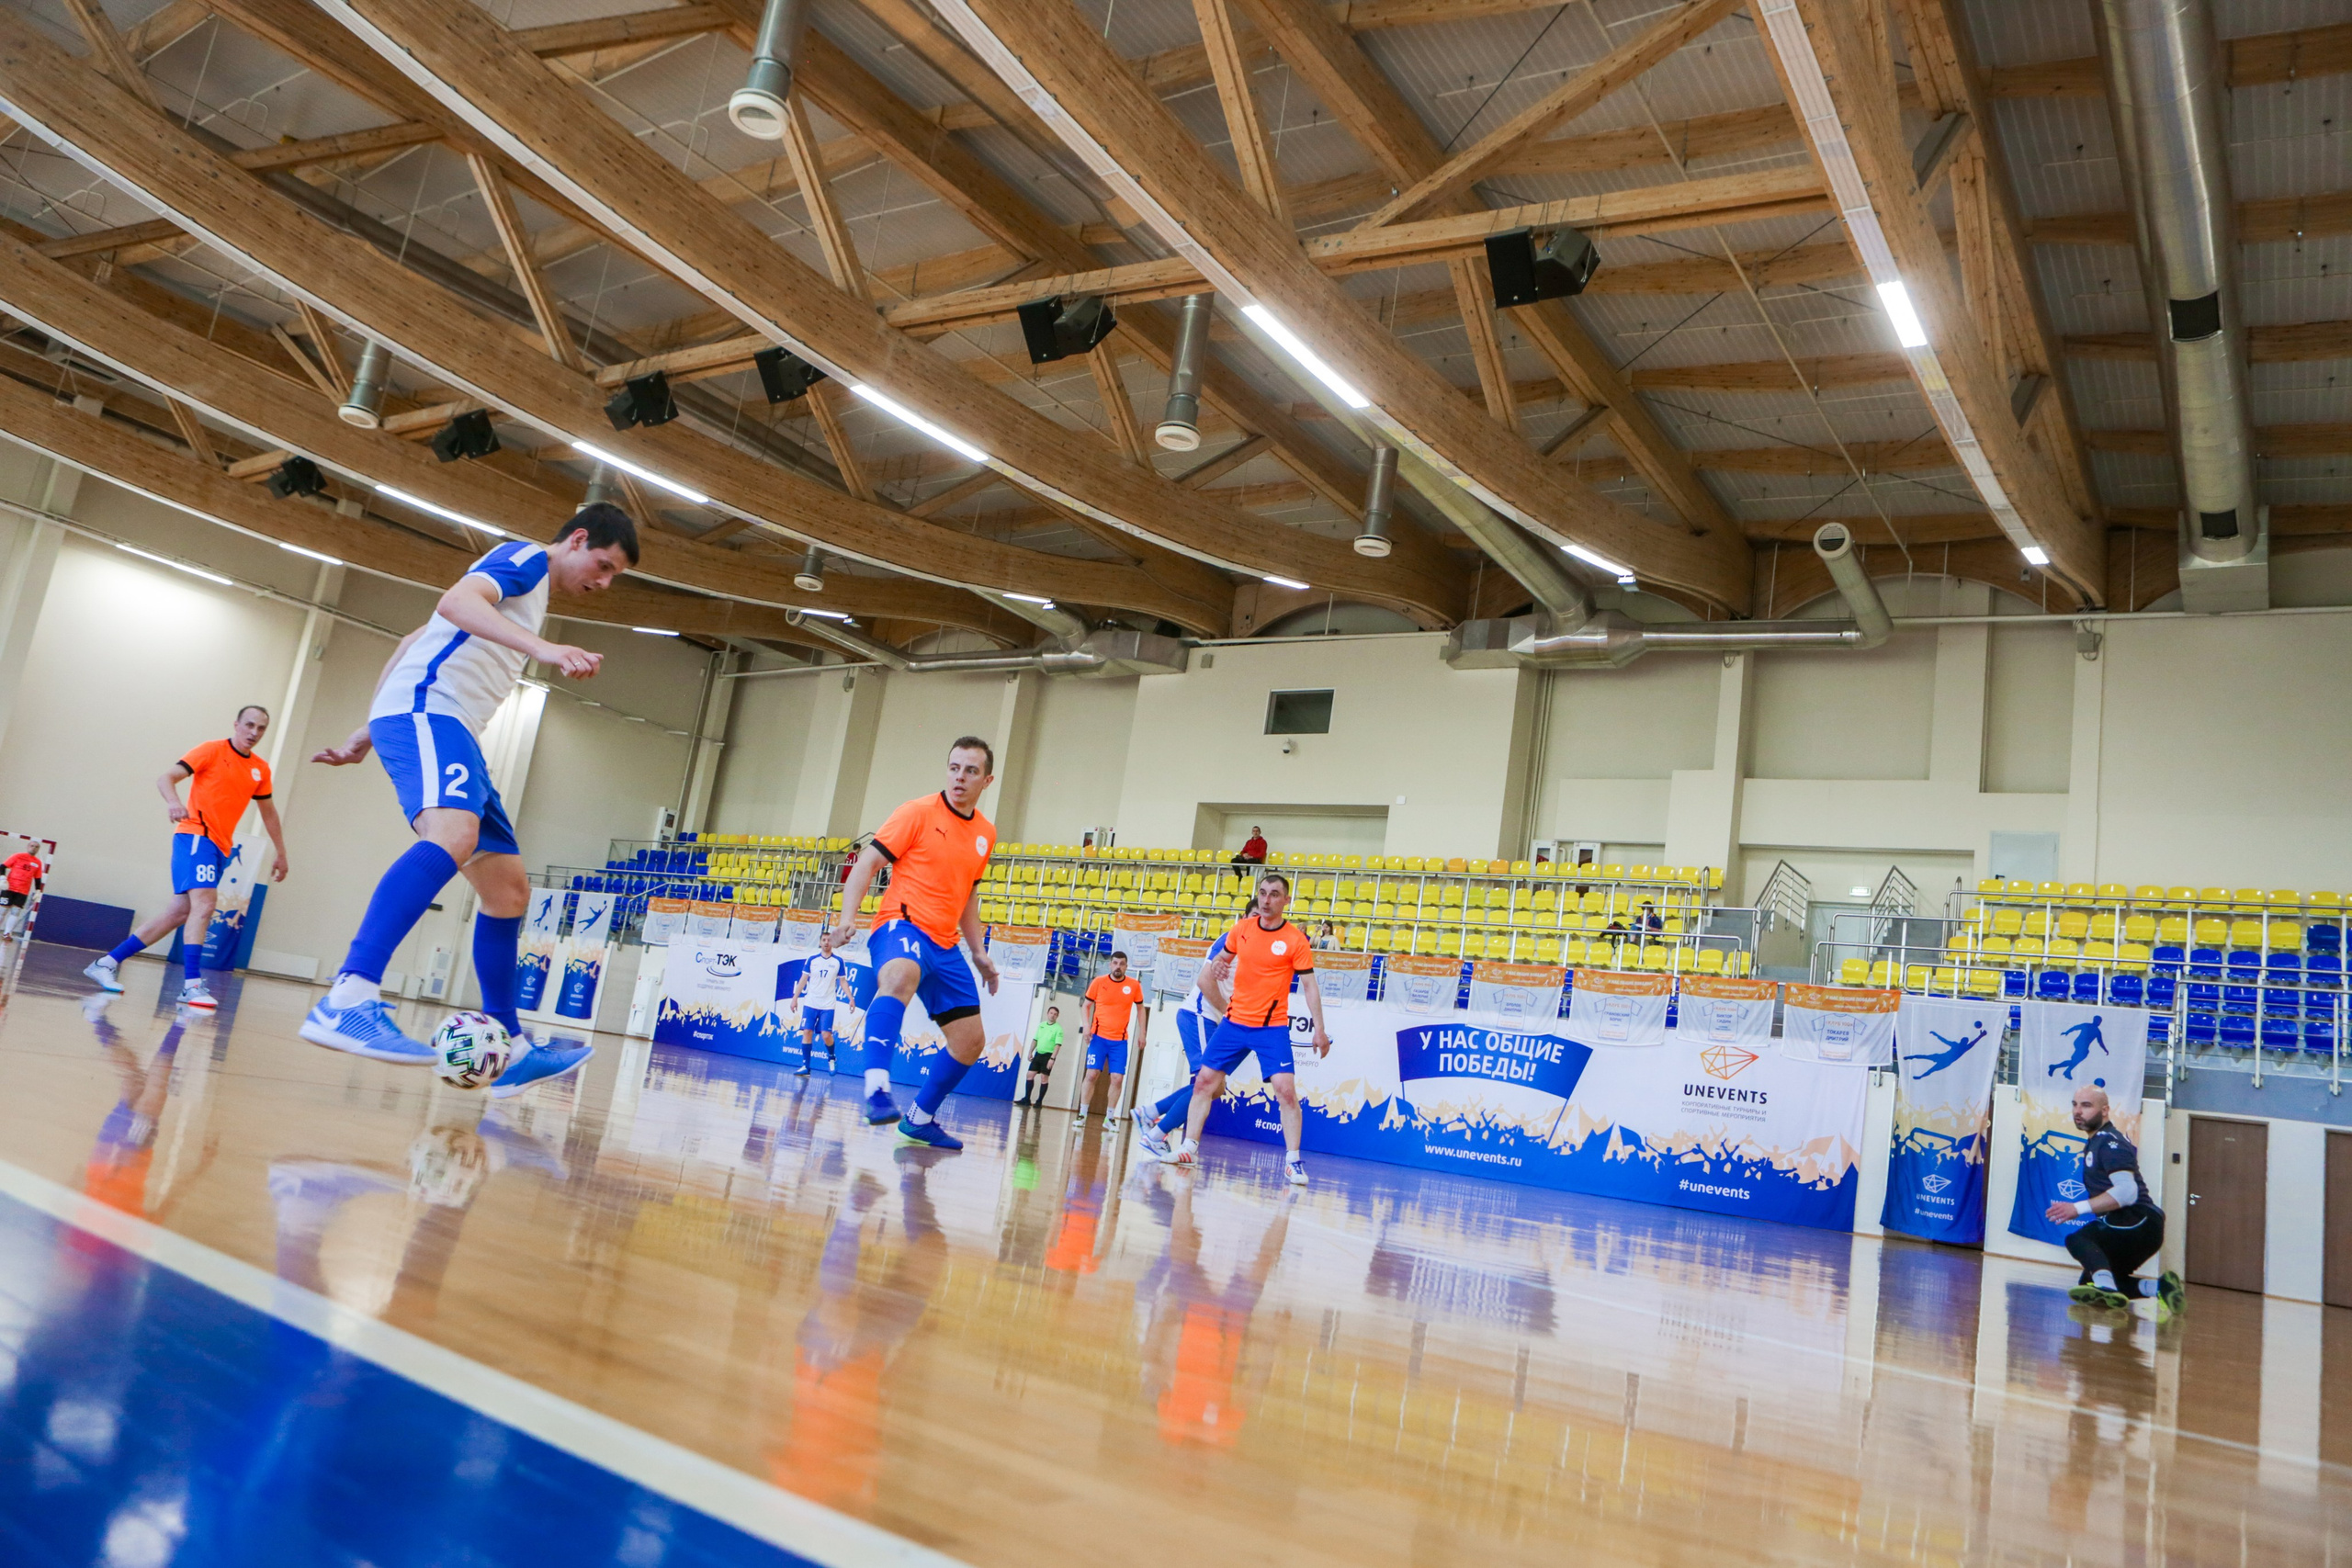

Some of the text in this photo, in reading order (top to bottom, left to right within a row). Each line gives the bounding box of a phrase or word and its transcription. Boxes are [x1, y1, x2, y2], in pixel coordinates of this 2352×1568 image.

[445, 762, 469, 799] 2
[196, 864, 215, 882] 86
[899, 937, 921, 959] 14
[820, 969, 829, 978] 17
[1419, 1030, 1565, 1064] У НАС ОБЩИЕ
[1087, 1055, 1095, 1066] 25
[1439, 1054, 1537, 1082] ПОБЕДЫ!
[1683, 1083, 1768, 1105] UNEVENTS
[1680, 1107, 1767, 1122] СПОРТИВНЫЕ МЕРОПРИЯТИЯ
[1681, 1101, 1731, 1111] КОРПОРАТИВНЫЕ
[1733, 1106, 1760, 1115] ТУРНИРЫ
[1425, 1144, 1522, 1167] www.unevents.ru
[1679, 1179, 1750, 1200] #unevents
[1916, 1193, 1955, 1205] UNEVENTS
[1915, 1207, 1953, 1221] #unevents
